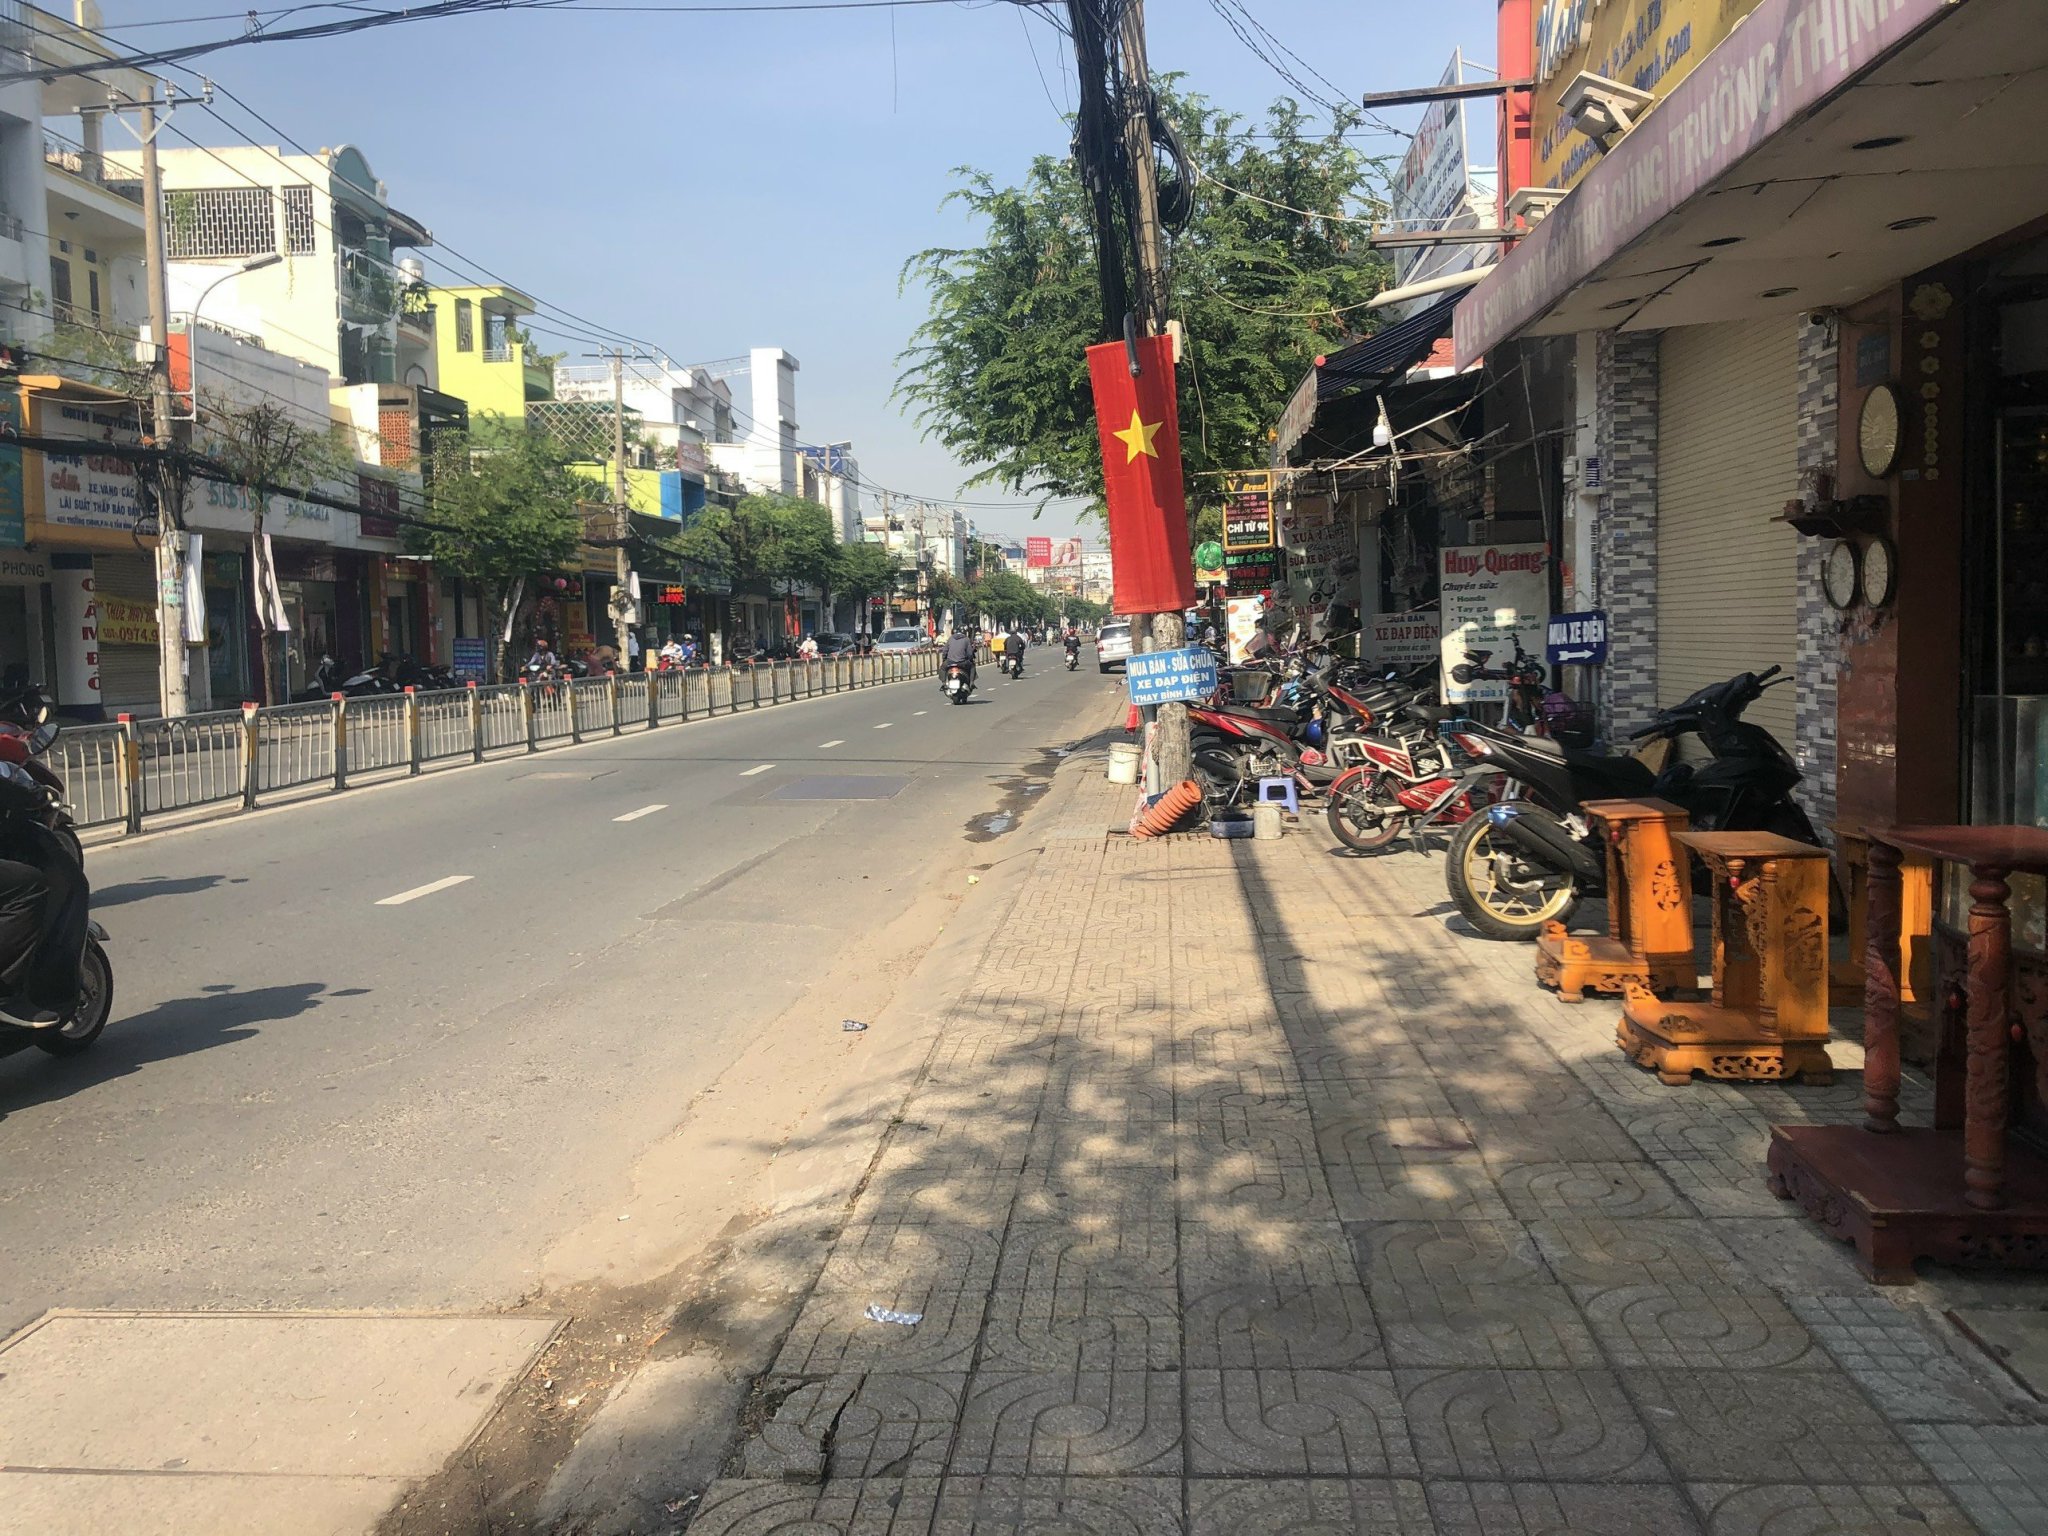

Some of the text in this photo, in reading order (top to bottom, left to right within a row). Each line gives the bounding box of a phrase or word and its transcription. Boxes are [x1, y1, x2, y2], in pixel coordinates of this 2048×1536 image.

[1458, 302, 1480, 356] 414
[1574, 184, 1606, 268] THỜ
[1612, 146, 1664, 227] CÚNG
[1668, 42, 1777, 188] TRƯỜNG
[1785, 0, 1905, 88] THỊN
[1243, 482, 1267, 491] Bread
[1227, 519, 1269, 534] CHỈ TỪ 9K
[1445, 547, 1545, 577] Huy Quang
[1442, 580, 1499, 592] Chuyên sửa:
[1457, 595, 1486, 603] Honda
[1387, 614, 1425, 623] UA BÁN
[1457, 616, 1479, 624] Thay
[1376, 623, 1439, 643] XE ĐẠP ĐIỆN
[1548, 615, 1605, 648] MUA XE ĐIỆN
[1129, 660, 1148, 677] MUA
[1148, 656, 1166, 675] BÁN
[1171, 651, 1189, 672] SỬA
[1190, 650, 1213, 670] CHỮA
[1137, 671, 1210, 690] XE ĐẠP ĐIỆN
[1134, 693, 1158, 703] THAY
[1160, 688, 1182, 699] BÌNH
